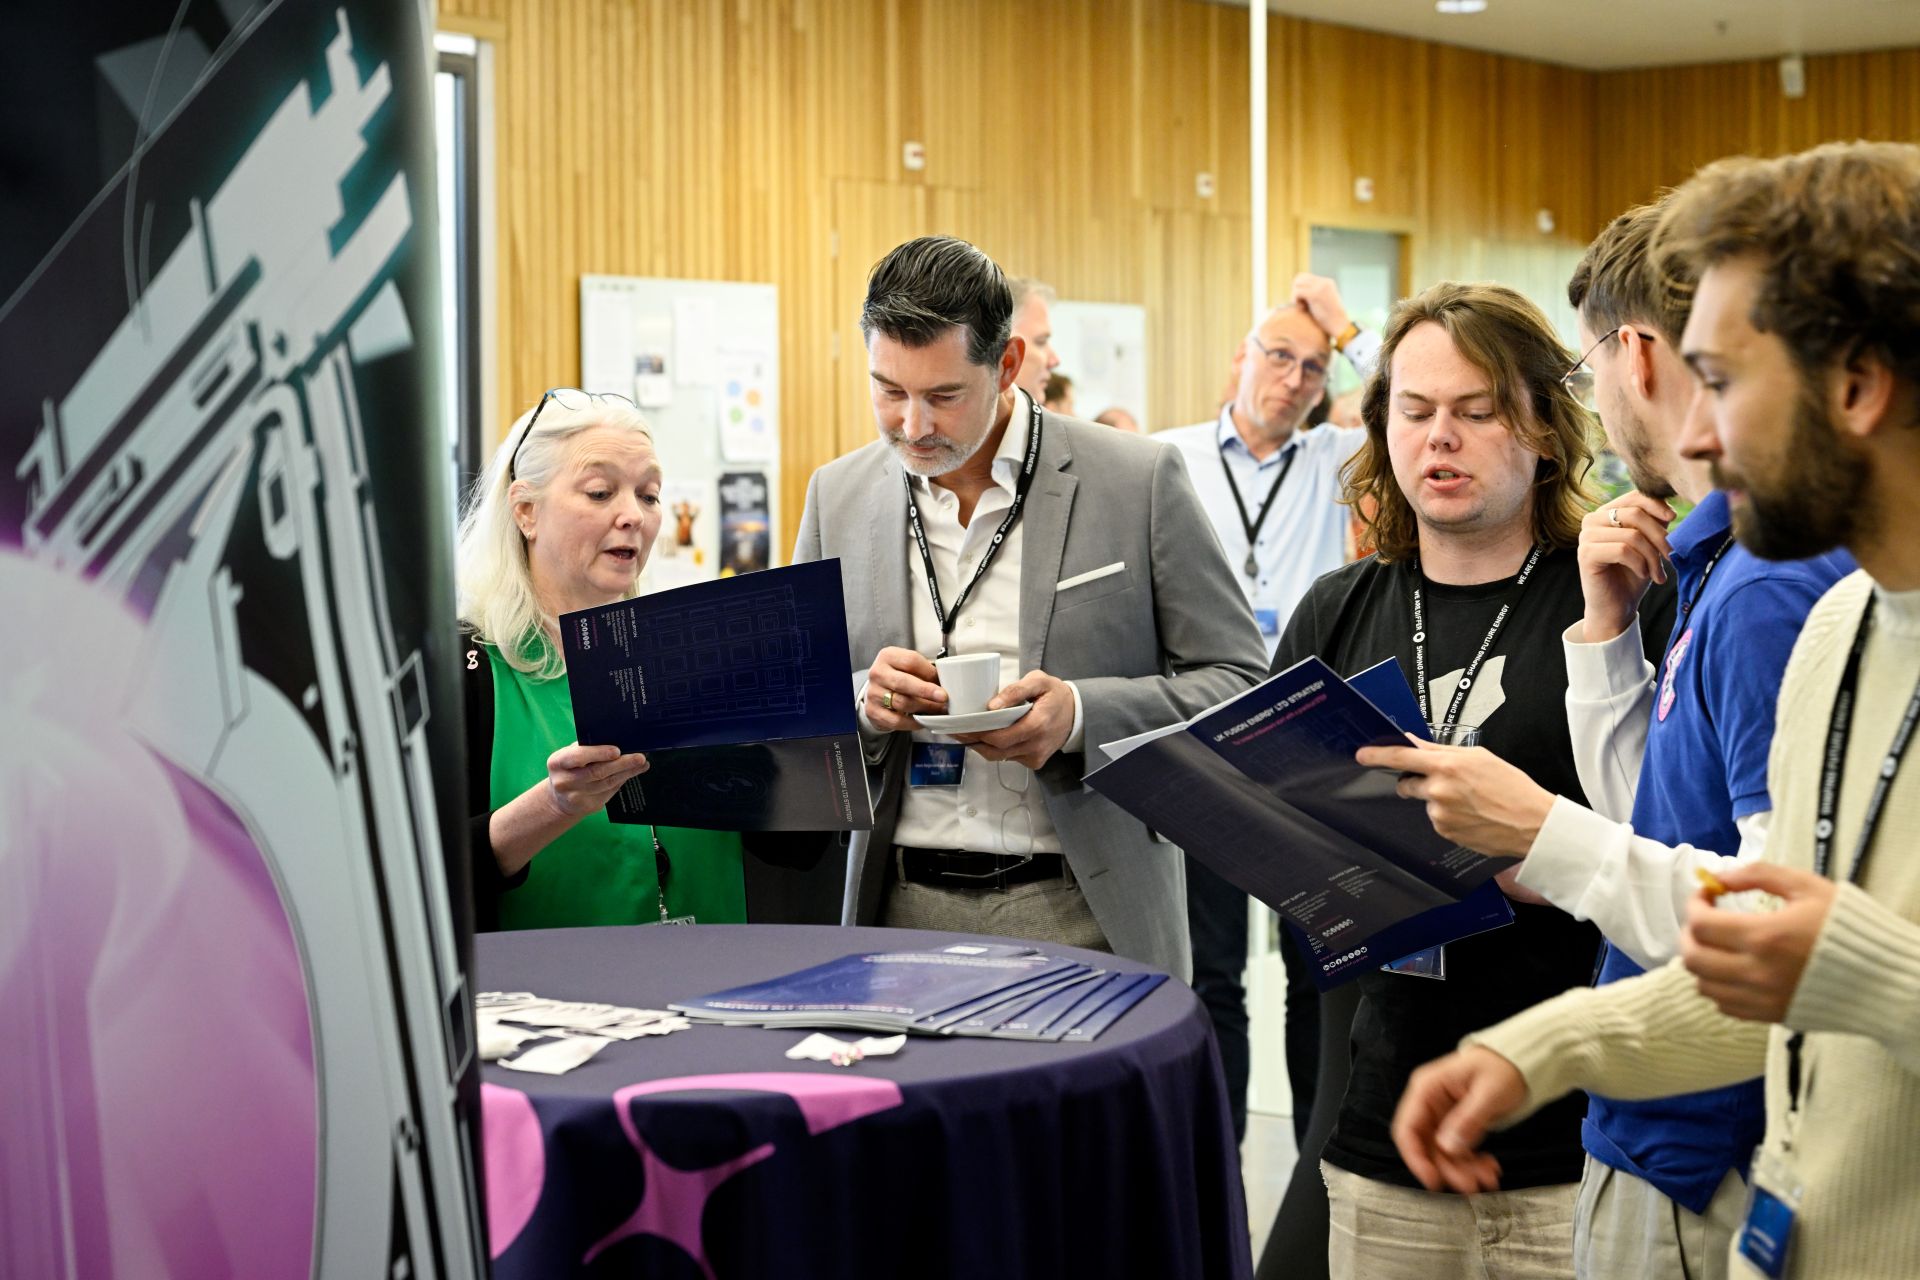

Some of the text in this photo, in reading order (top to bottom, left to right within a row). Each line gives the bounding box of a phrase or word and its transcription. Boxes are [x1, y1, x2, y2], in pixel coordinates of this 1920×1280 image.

[1030, 433, 1039, 453] FUTURE
[1025, 453, 1036, 475] ENERGY
[1516, 545, 1543, 585] WE ARE DIFFE
[1414, 610, 1423, 631] DIFFER
[1467, 604, 1510, 676] SHAPING FUTURE ENERGY
[1416, 645, 1428, 719] SHAPING FUTURE ENERGY
[1223, 722, 1249, 738] FUSION
[1246, 707, 1275, 726] ENERGY
[1287, 680, 1326, 704] STRATEGY
[1450, 691, 1465, 714] DIFFER
[835, 750, 844, 770] FUSION
[838, 770, 847, 789] ENERGY
